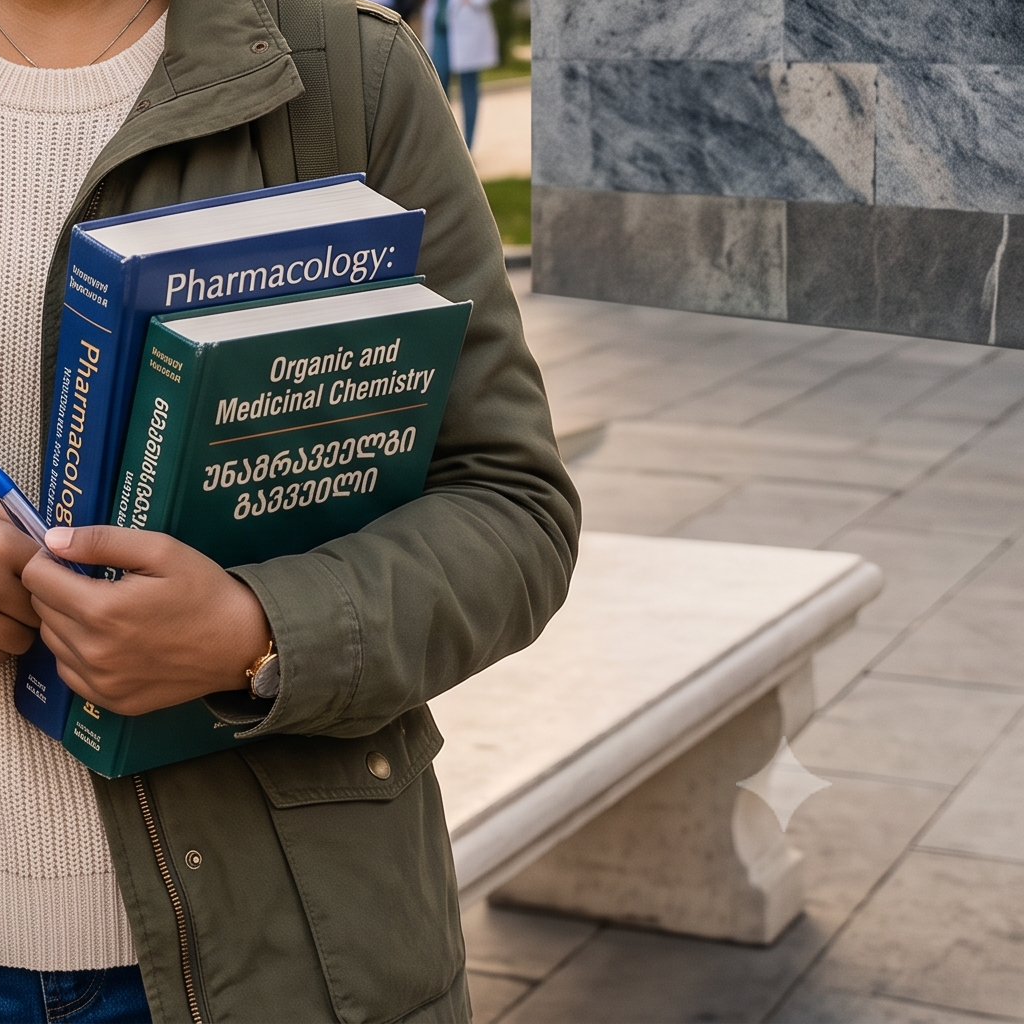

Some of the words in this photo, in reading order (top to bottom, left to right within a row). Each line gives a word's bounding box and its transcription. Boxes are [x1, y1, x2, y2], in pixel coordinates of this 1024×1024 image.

[165, 246, 394, 306] Pharmacology:
[270, 347, 353, 385] Organic
[360, 338, 400, 367] and
[216, 384, 324, 425] Medicinal
[329, 368, 435, 404] Chemistry
[55, 339, 100, 528] Pharmacolog
